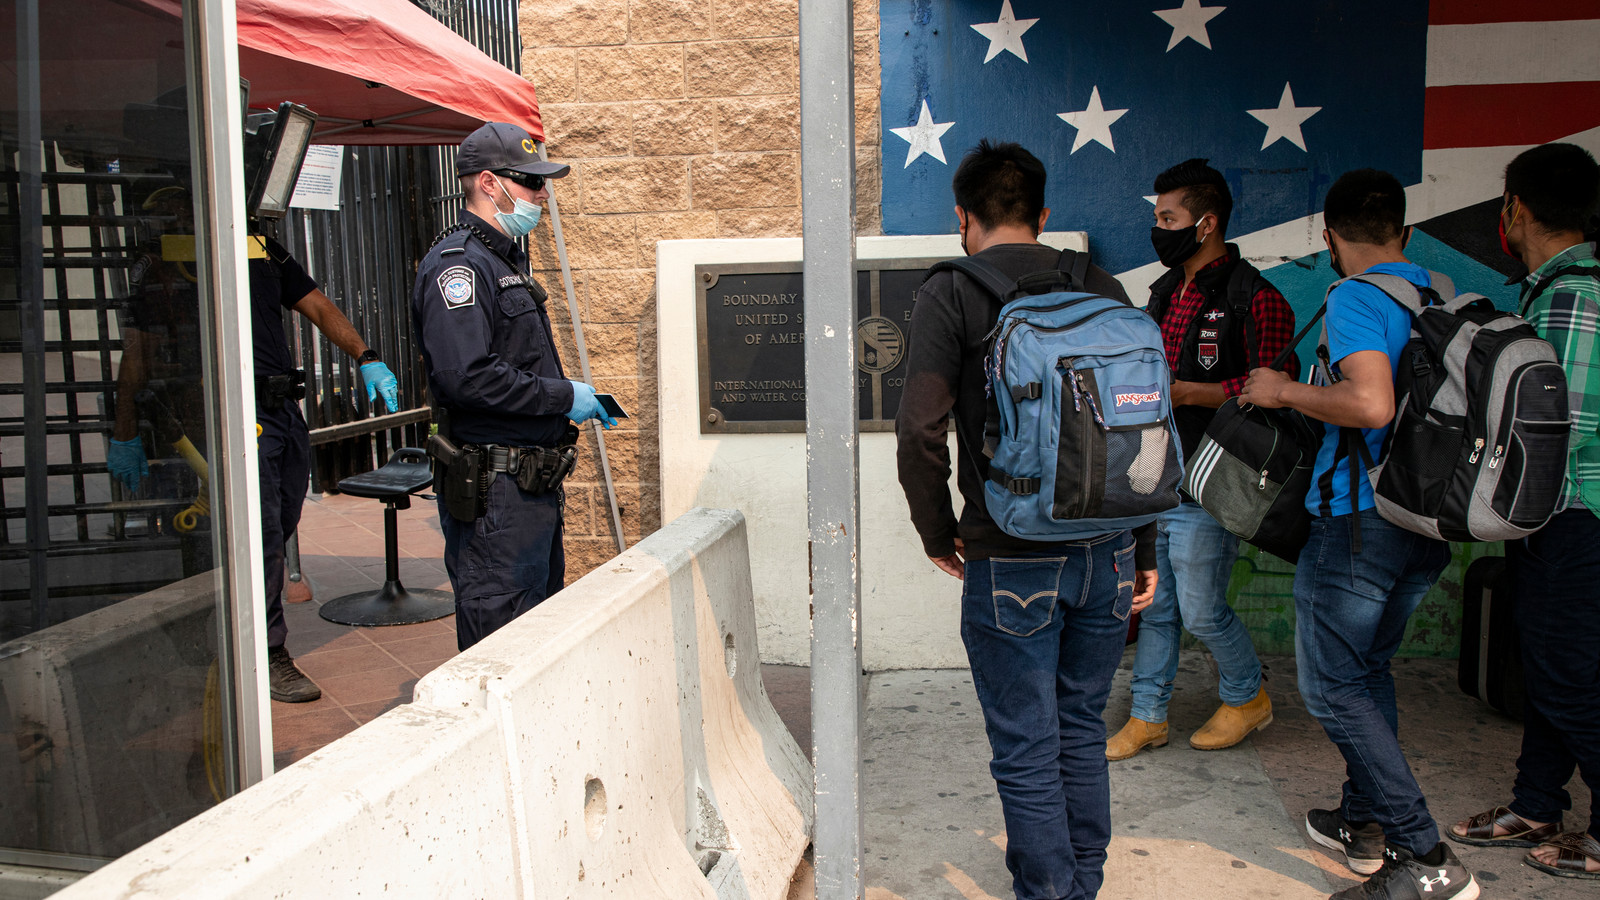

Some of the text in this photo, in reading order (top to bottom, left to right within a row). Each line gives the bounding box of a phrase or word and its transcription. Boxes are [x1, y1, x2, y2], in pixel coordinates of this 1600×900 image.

[723, 293, 798, 306] BOUNDARY
[735, 314, 788, 326] UNITED
[745, 332, 805, 345] OF AMER
[714, 379, 804, 391] INTERNATIONAL
[721, 393, 746, 403] AND
[751, 392, 788, 403] WATER
